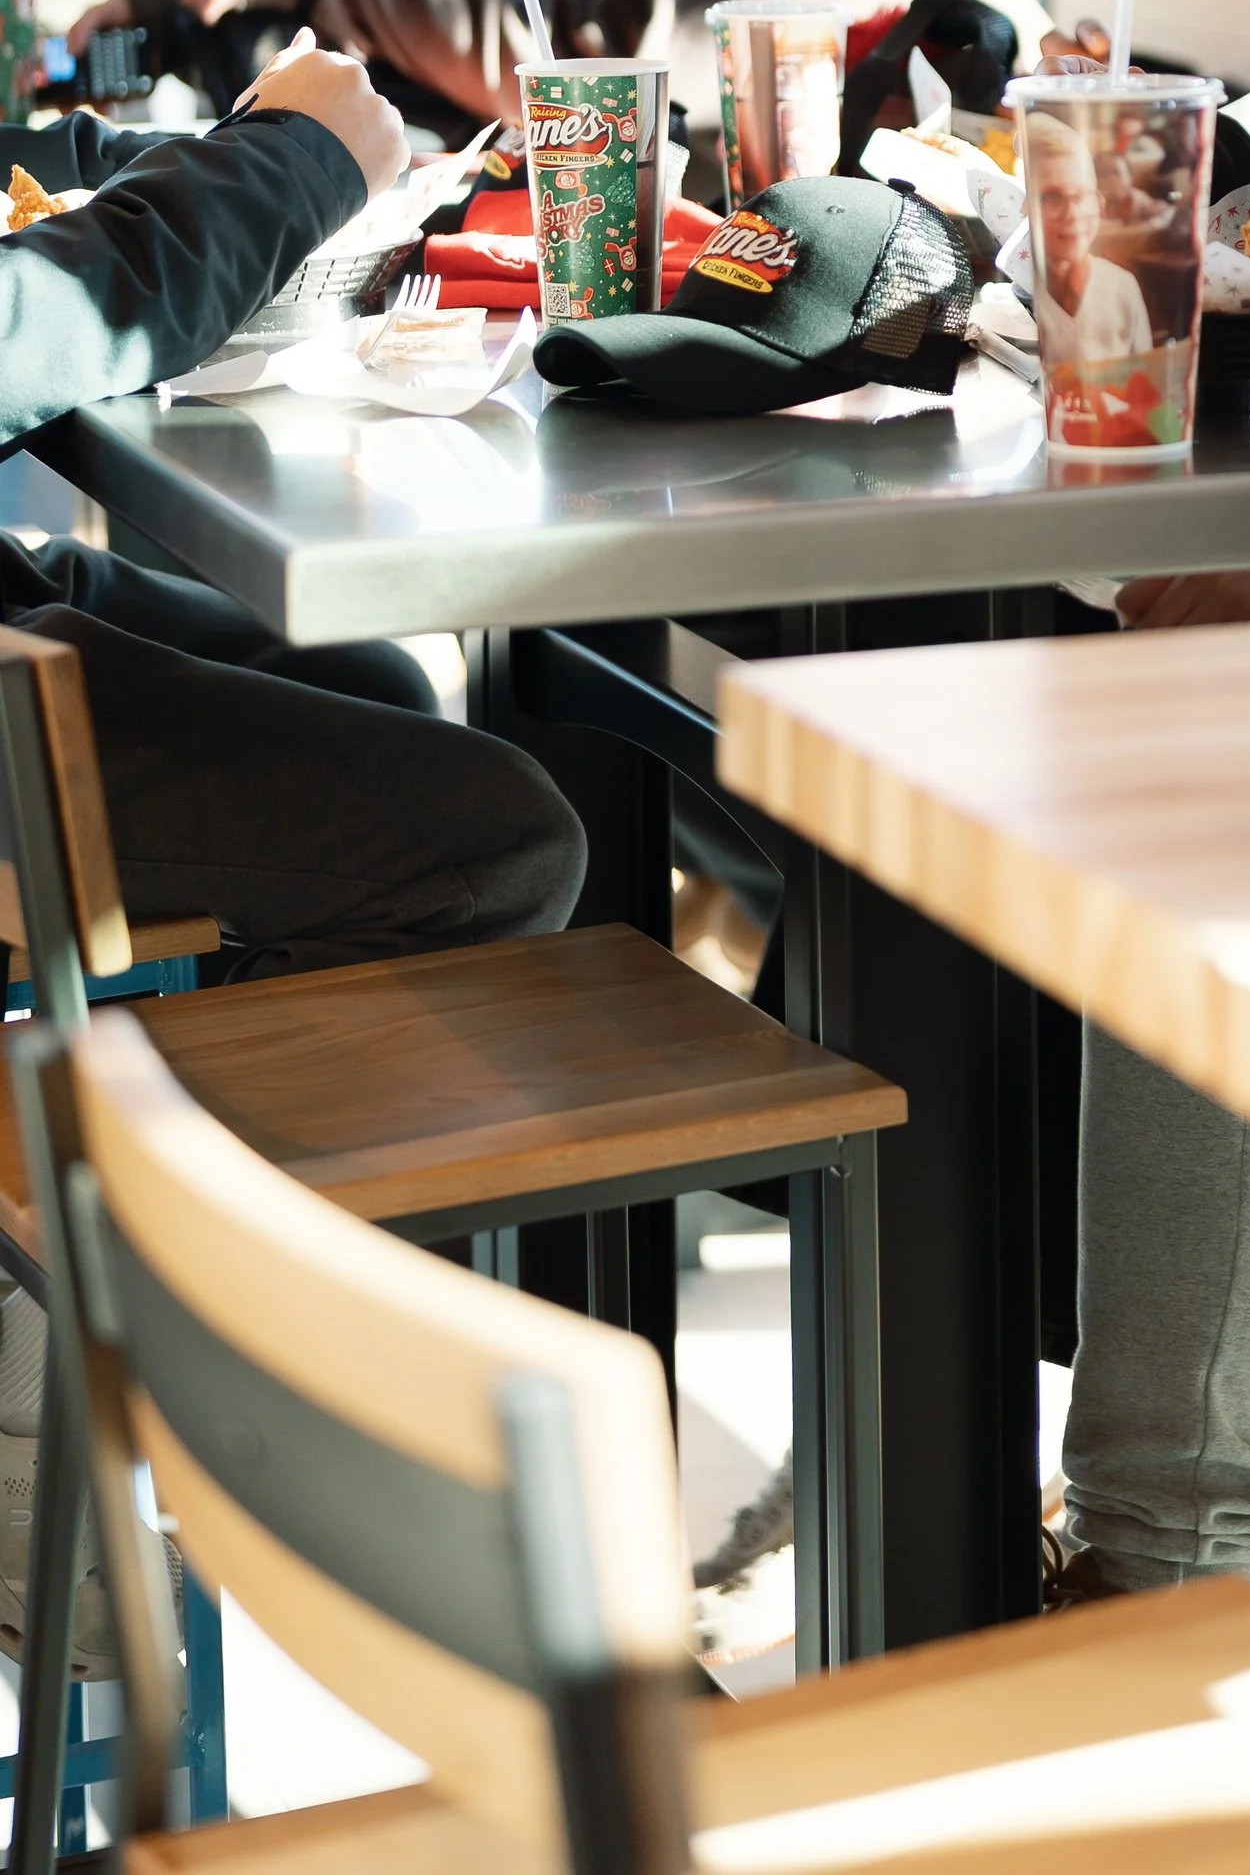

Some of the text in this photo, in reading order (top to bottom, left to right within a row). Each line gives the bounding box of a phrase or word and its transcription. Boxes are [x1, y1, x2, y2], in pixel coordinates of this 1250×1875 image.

[528, 105, 607, 148] ane's
[530, 106, 567, 120] Raising
[539, 196, 604, 231] STMAS
